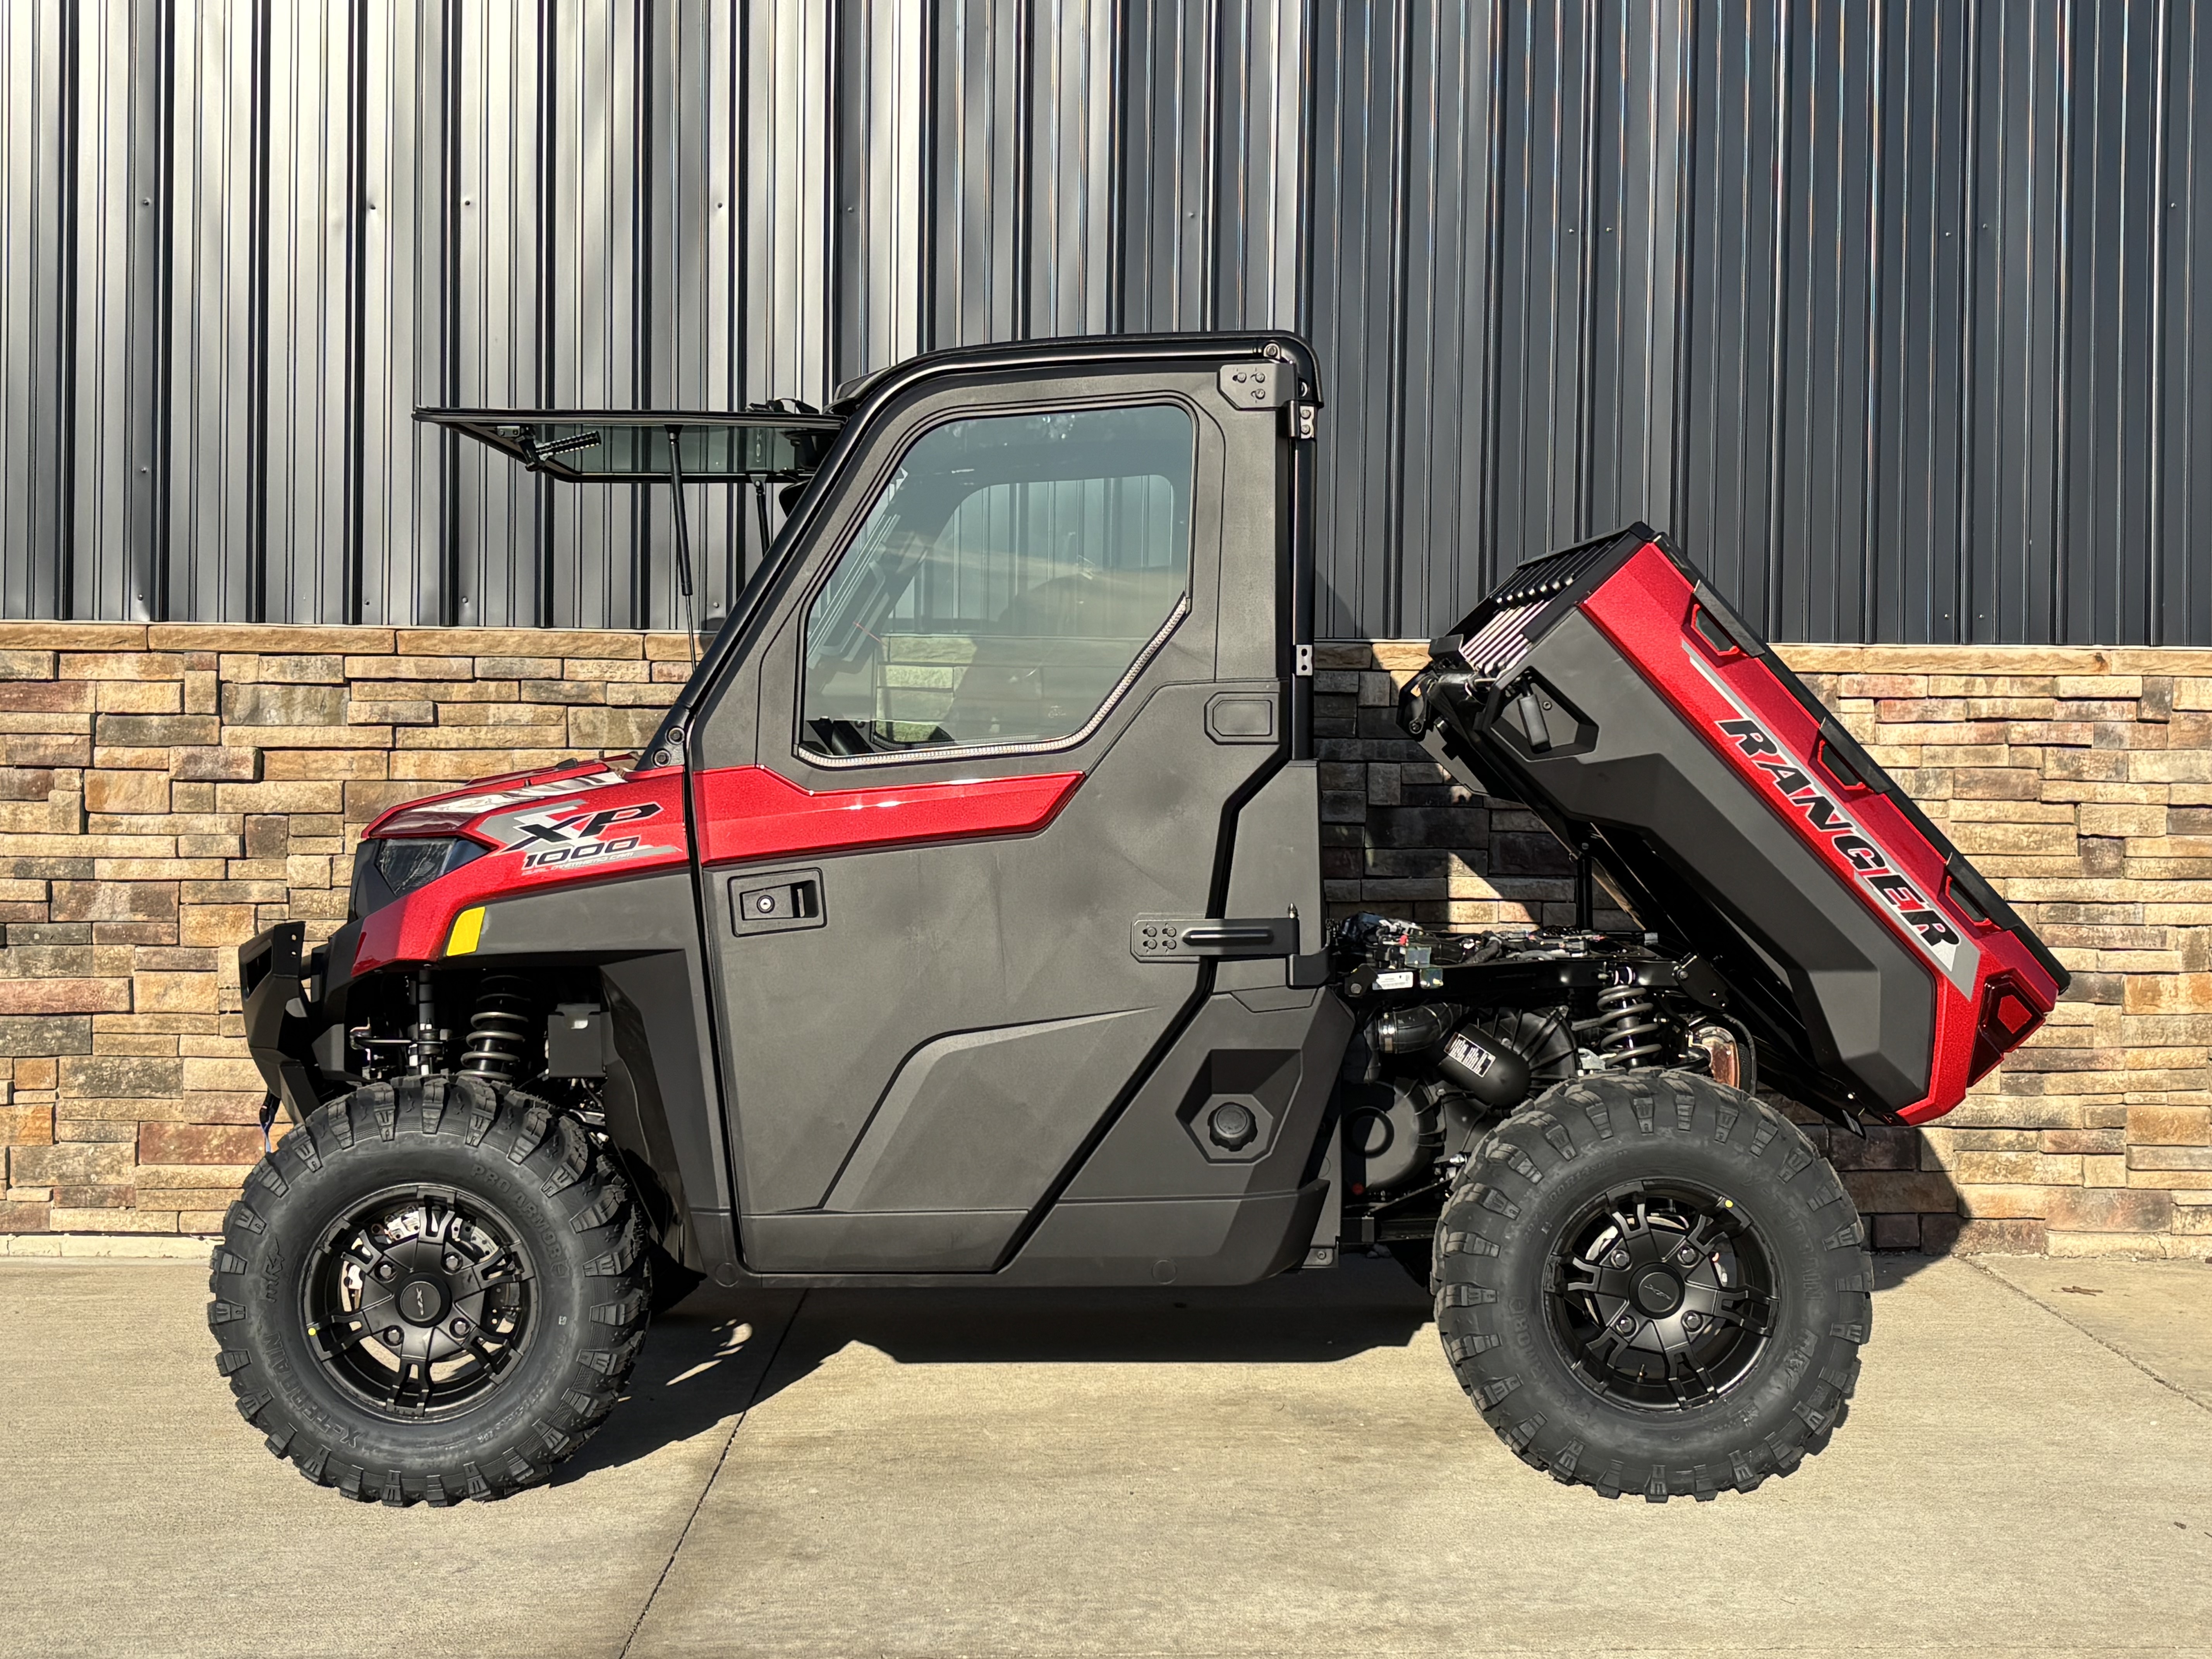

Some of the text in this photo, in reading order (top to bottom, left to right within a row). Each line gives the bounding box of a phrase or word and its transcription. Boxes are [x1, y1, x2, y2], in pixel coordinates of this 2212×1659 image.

[500, 802, 663, 853] XP
[523, 835, 641, 868] 1000
[609, 852, 634, 860] CAM
[1715, 718, 1961, 947] RANGER
[470, 1164, 562, 1258] PRO ARMOR
[261, 1332, 362, 1448] X-TERRAIN
